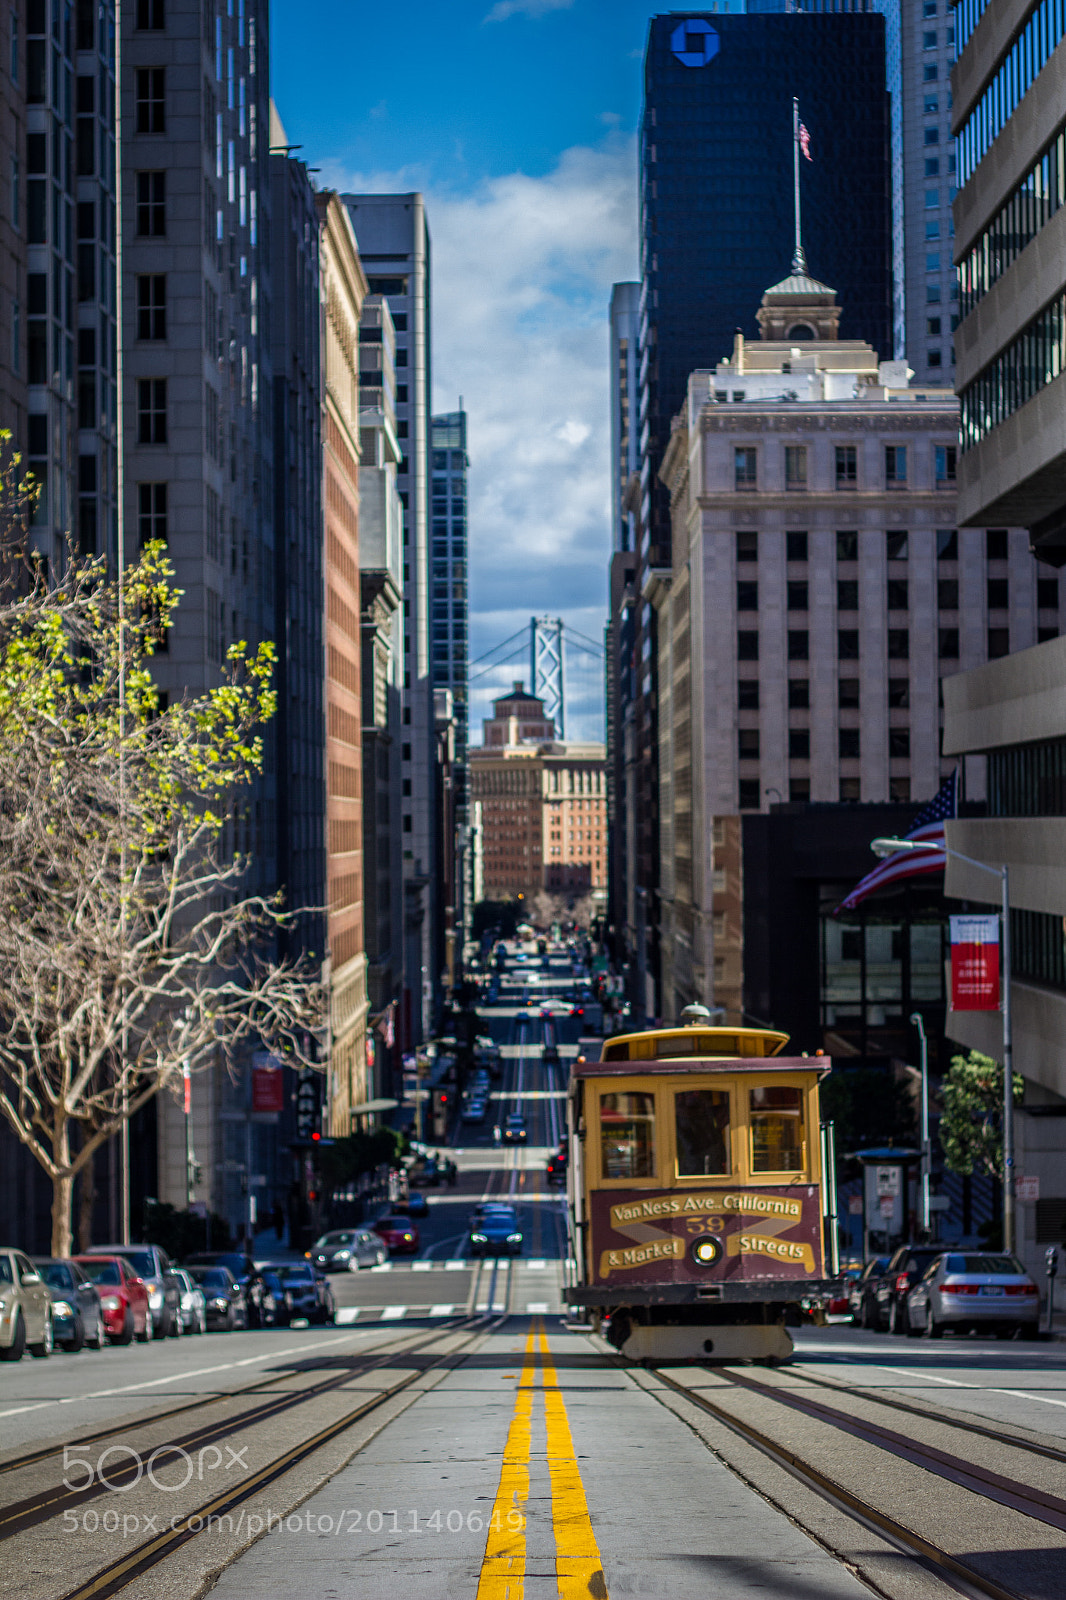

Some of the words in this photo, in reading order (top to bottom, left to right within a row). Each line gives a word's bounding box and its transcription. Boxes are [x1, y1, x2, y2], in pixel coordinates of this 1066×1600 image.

[614, 1205, 641, 1221] Van
[642, 1200, 681, 1216] Ness
[723, 1194, 799, 1216] California
[686, 1216, 725, 1234] 59
[608, 1251, 620, 1266] &
[623, 1241, 679, 1264] Market
[739, 1236, 804, 1258] Streets
